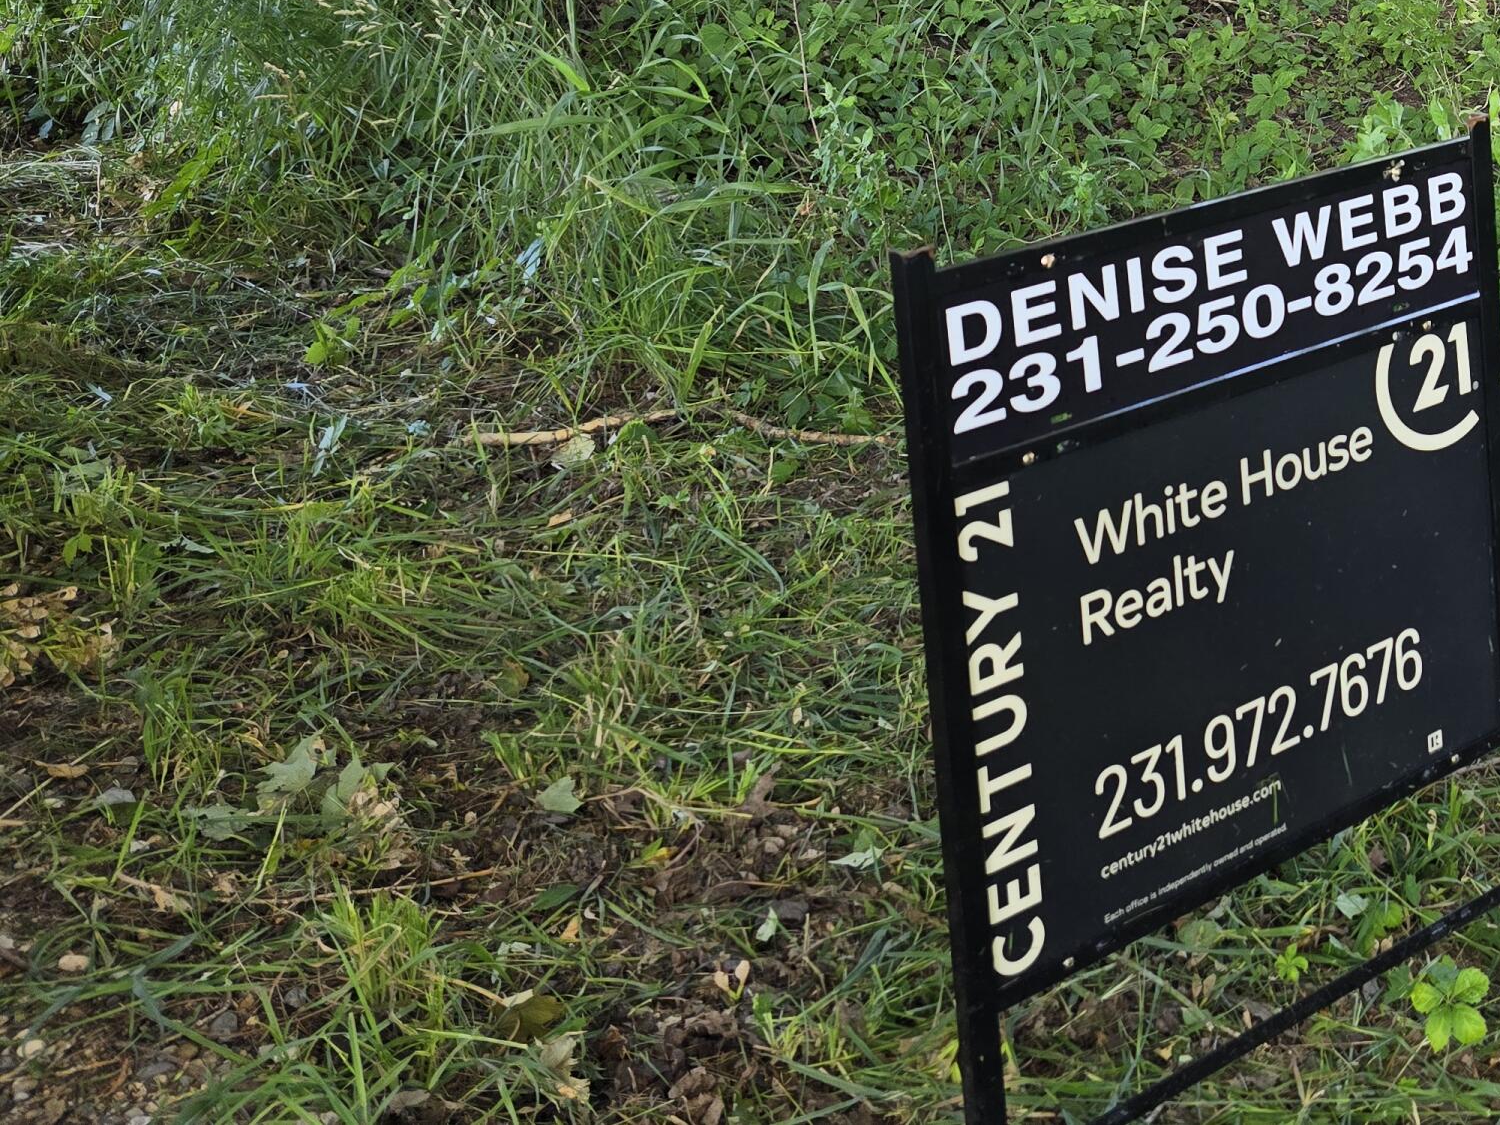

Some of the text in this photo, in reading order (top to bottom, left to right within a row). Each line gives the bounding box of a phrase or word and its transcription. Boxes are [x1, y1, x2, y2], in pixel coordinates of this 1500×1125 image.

[944, 172, 1467, 367] DENISE WEBB
[950, 226, 1473, 435] 231-250-8254
[1073, 426, 1374, 565] White House
[1080, 549, 1235, 645] Realty
[954, 480, 1046, 977] CENTURY 21
[1095, 627, 1423, 839] 231.972.7676
[1100, 779, 1282, 879] century21whitehouse.com
[1103, 908, 1125, 924] Each
[1125, 894, 1149, 913] office
[1149, 890, 1157, 900] is
[1157, 861, 1212, 896] independently
[1213, 847, 1239, 866] owned
[1239, 837, 1254, 853] and
